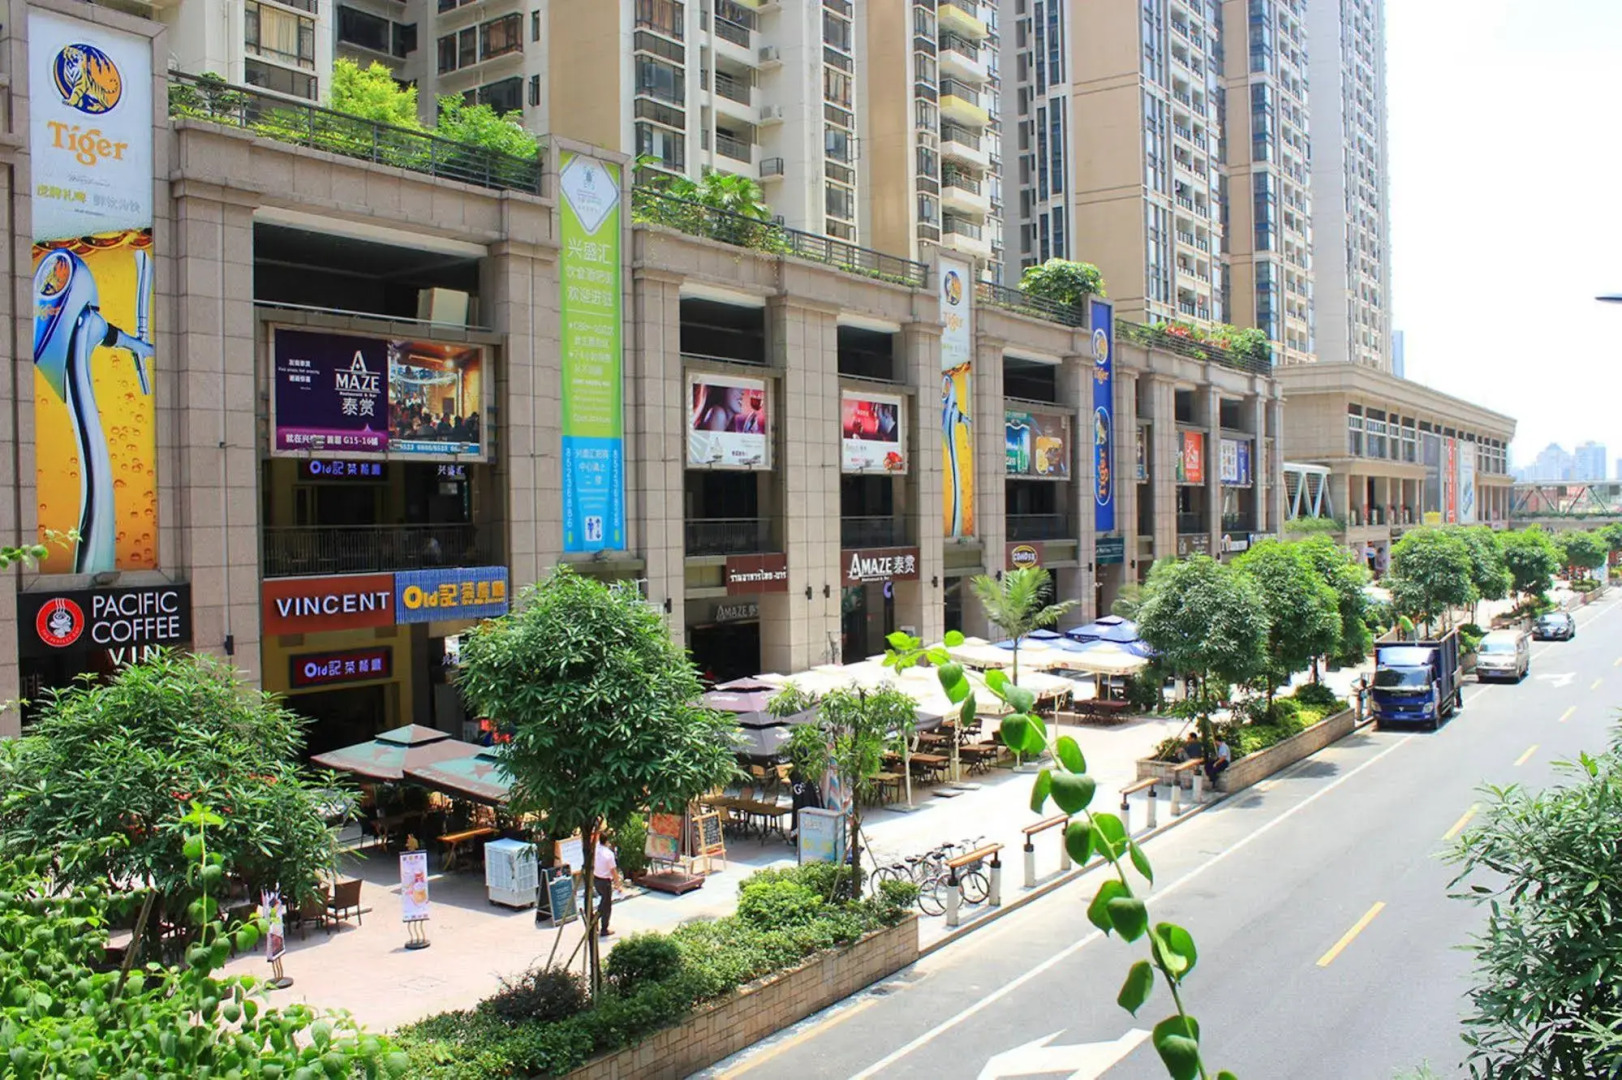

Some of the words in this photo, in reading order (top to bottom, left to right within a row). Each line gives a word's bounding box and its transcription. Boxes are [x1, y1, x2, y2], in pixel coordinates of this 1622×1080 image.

[47, 121, 128, 167] Tiger
[568, 237, 612, 264] 兴盛汇
[336, 373, 380, 391] MAZE
[342, 397, 375, 416] 泰赏
[847, 552, 892, 579] AMAZE
[893, 554, 915, 574] 泰赏
[92, 591, 178, 618] PACIFIC
[276, 591, 391, 617] VINCENT
[91, 616, 180, 644] COFFEE
